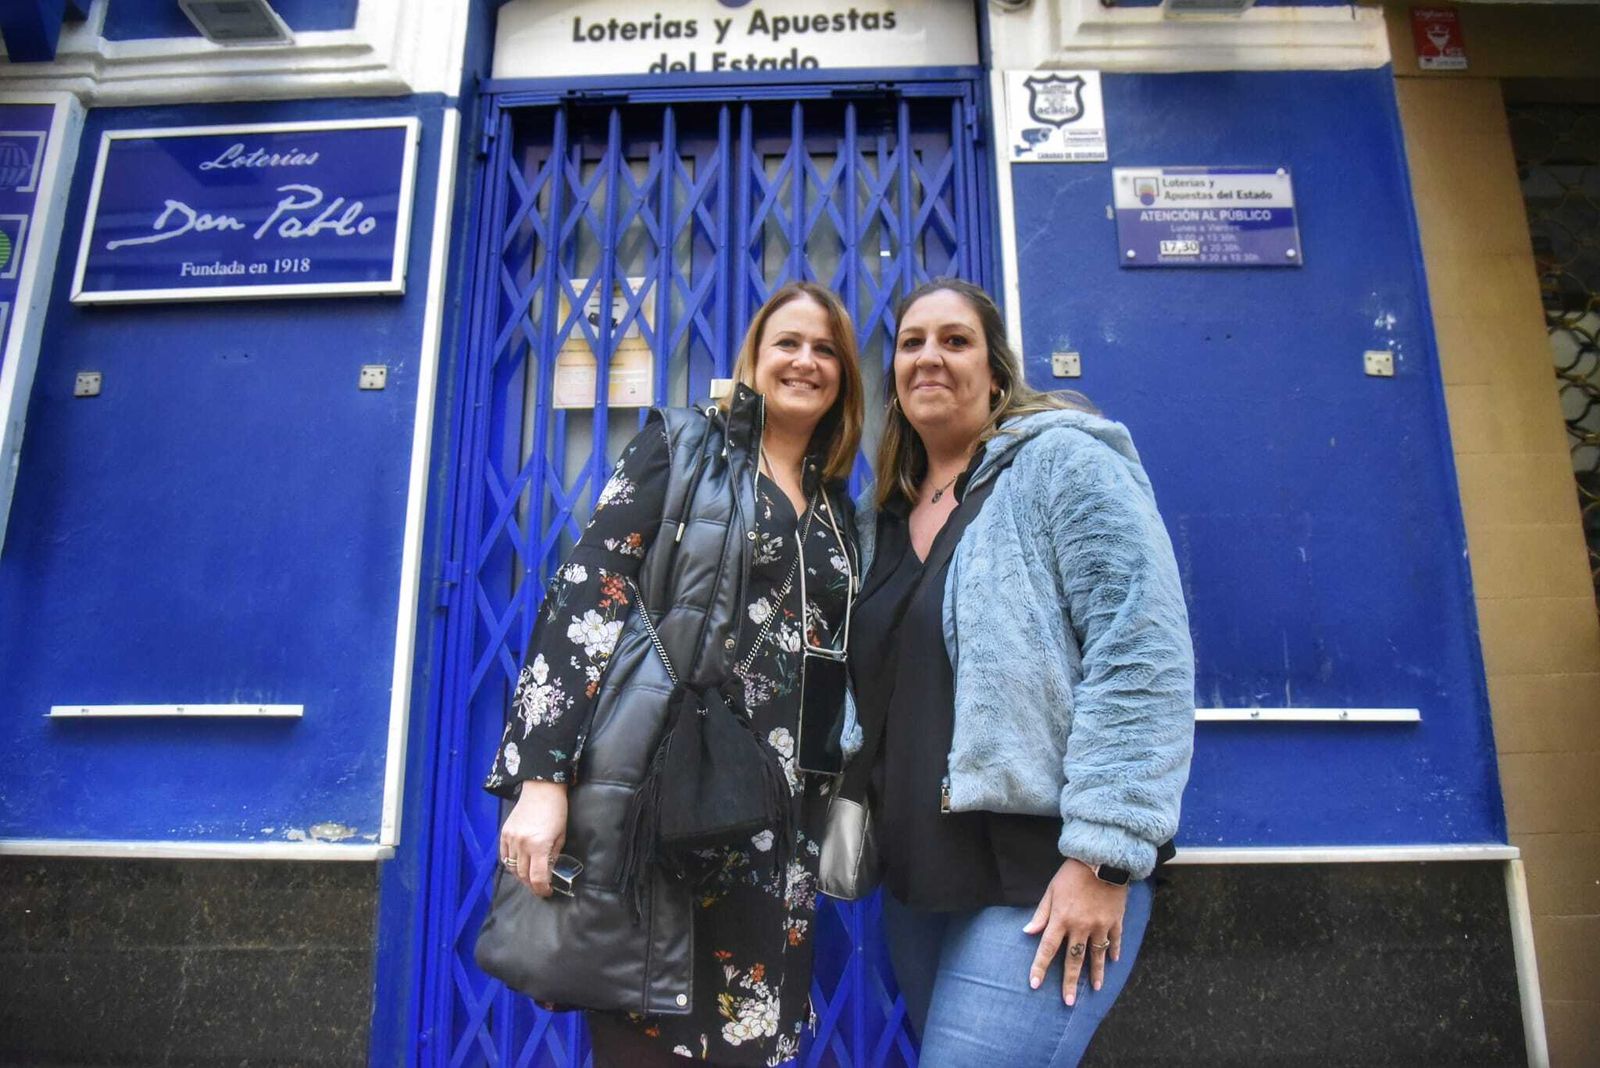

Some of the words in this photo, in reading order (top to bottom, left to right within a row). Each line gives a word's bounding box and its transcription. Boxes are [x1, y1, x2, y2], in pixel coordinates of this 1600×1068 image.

[573, 13, 698, 43] Loterias
[713, 18, 733, 45] y
[747, 8, 897, 42] Apuestas
[649, 51, 697, 74] del
[712, 47, 820, 72] Estado
[1209, 179, 1215, 188] y
[1164, 191, 1214, 201] Apuestas
[1216, 189, 1233, 199] del
[1236, 189, 1273, 200] Estado
[106, 199, 246, 251] Don
[252, 184, 377, 240] Pablo
[1140, 208, 1200, 222] ATENCIÓN
[1202, 209, 1218, 221] AL
[1219, 207, 1272, 221] PÚBLICO
[180, 261, 246, 277] Fundada
[249, 263, 268, 275] en
[273, 257, 311, 274] 1918
